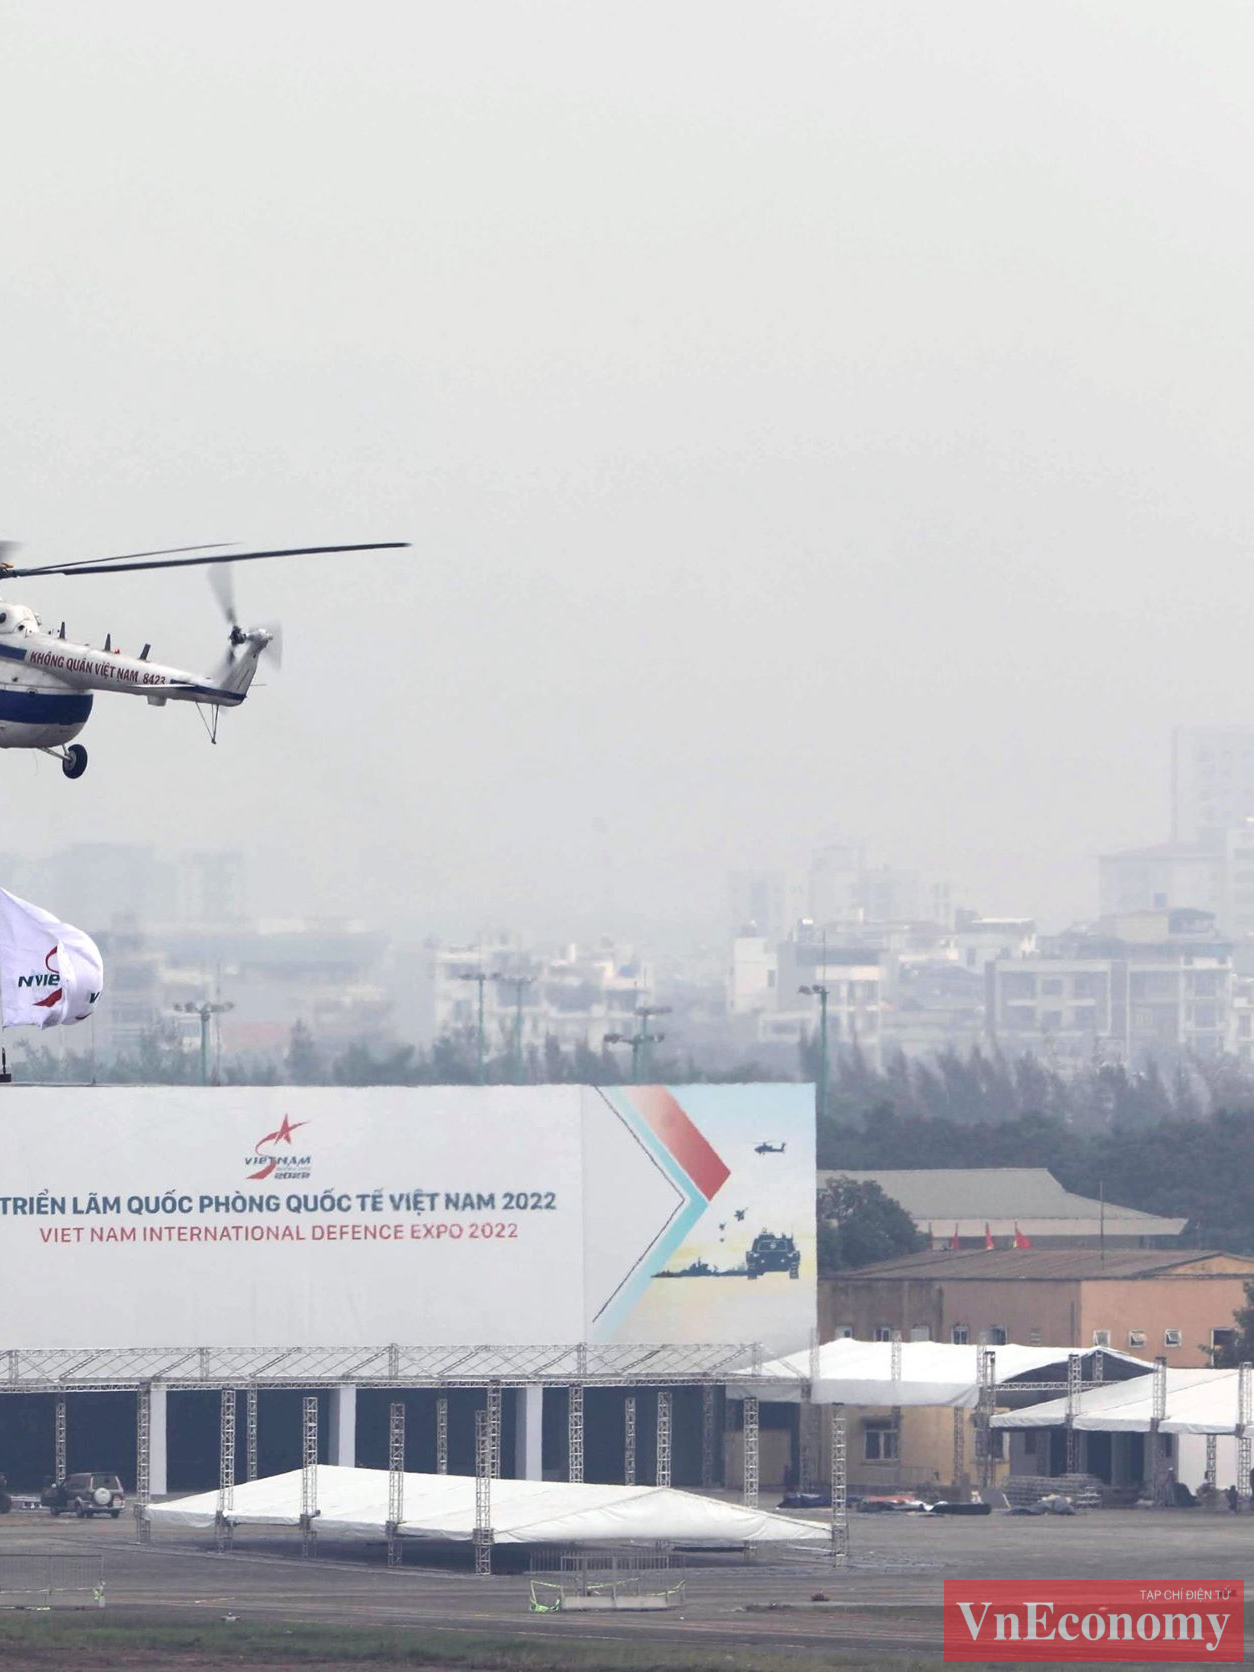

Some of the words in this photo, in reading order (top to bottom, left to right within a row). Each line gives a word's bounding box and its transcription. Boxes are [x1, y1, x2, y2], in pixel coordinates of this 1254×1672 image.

[30, 651, 64, 668] KHÔNG
[66, 658, 92, 674] QUÂN
[95, 660, 116, 680] VIỆT
[117, 668, 138, 682] NAM
[142, 673, 166, 684] 8423
[73, 1192, 121, 1214] LÃM
[127, 1189, 192, 1215] QUỐC
[199, 1190, 280, 1213] PHÒNG
[286, 1187, 351, 1213] QUỐC
[356, 1187, 383, 1211] TẾ
[389, 1189, 439, 1215] VIỆT
[445, 1192, 496, 1211] NAM
[501, 1192, 557, 1210] 2022
[40, 1228, 84, 1242] VIET
[90, 1227, 136, 1242] NAM
[143, 1225, 305, 1241] INTERNATIONAL
[311, 1224, 404, 1240] DEFENCE
[410, 1223, 463, 1239] EXPO
[469, 1223, 518, 1238] 2022
